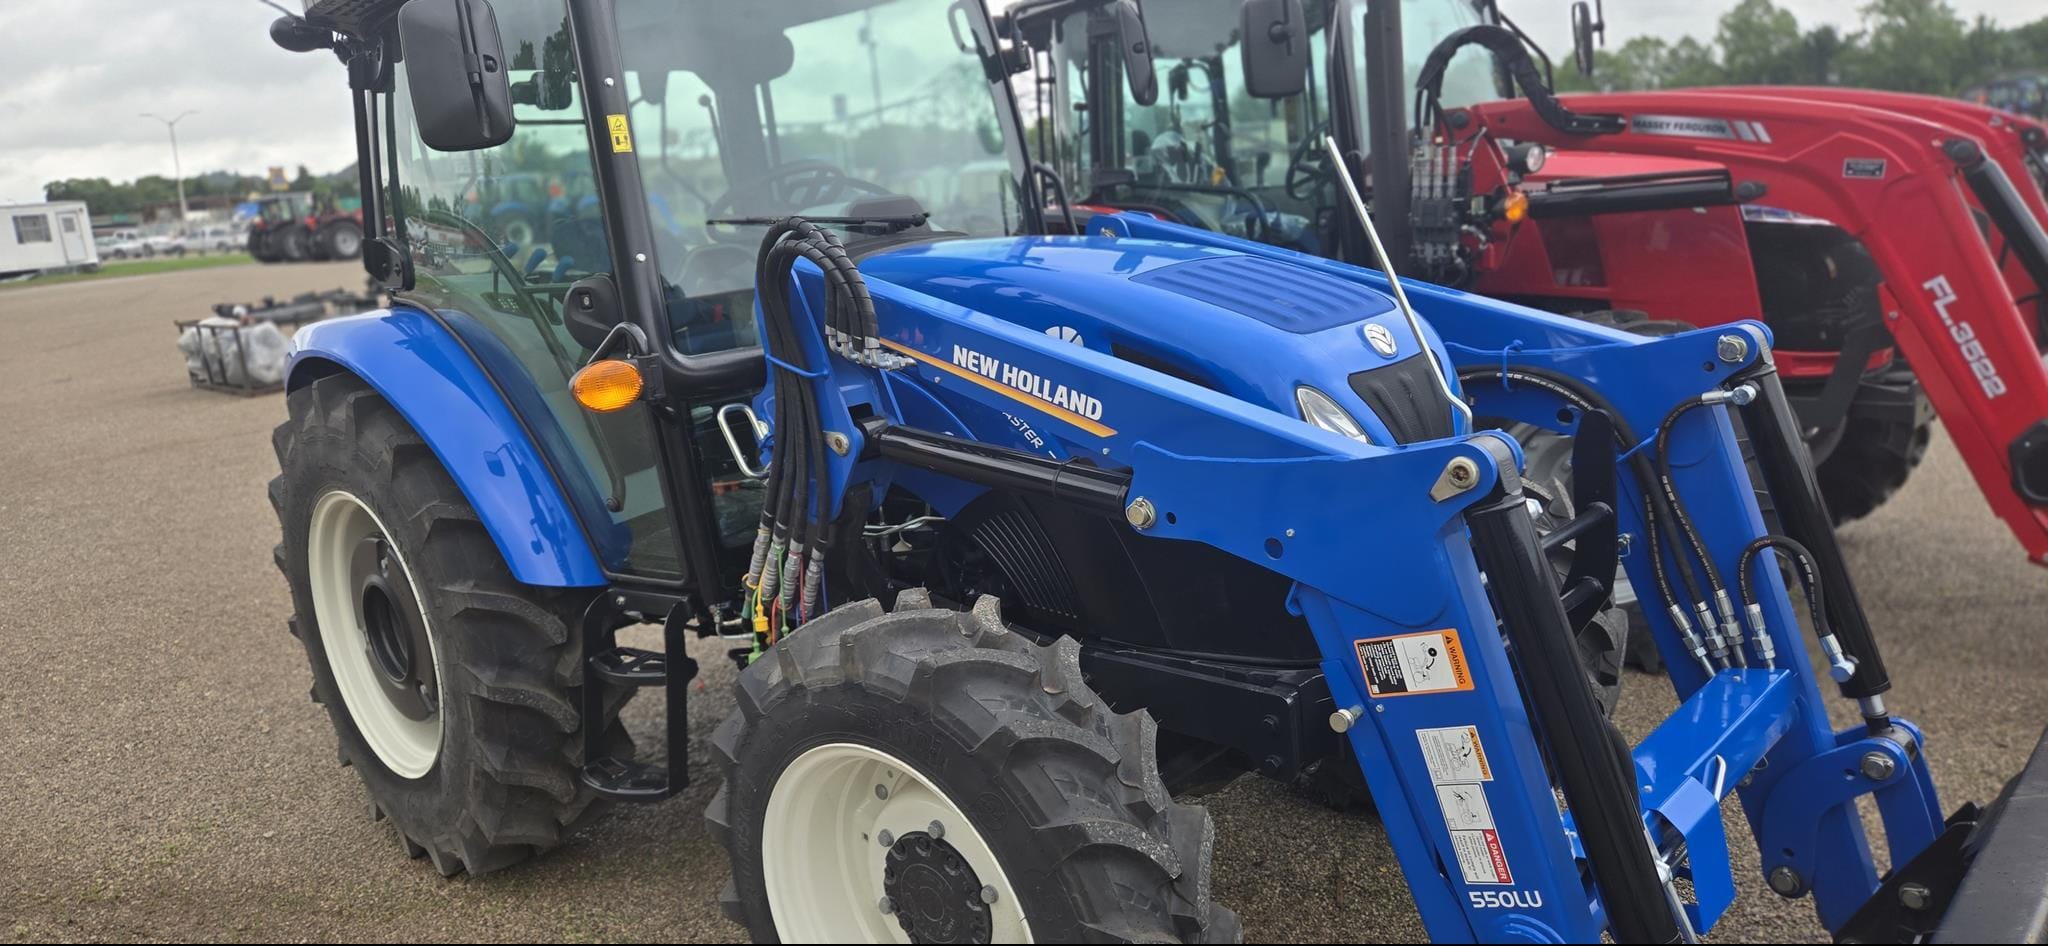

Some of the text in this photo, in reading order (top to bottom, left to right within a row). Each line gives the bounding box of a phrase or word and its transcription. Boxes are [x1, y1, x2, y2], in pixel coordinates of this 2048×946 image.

[1632, 119, 1727, 134] MASSEY FERGUSON
[953, 345, 1102, 421] NEW HOLLAND
[1448, 645, 1467, 685] WARNING
[1473, 737, 1488, 776] WARNING
[1489, 843, 1508, 880] DANGER
[1468, 889, 1543, 908] 550LU
